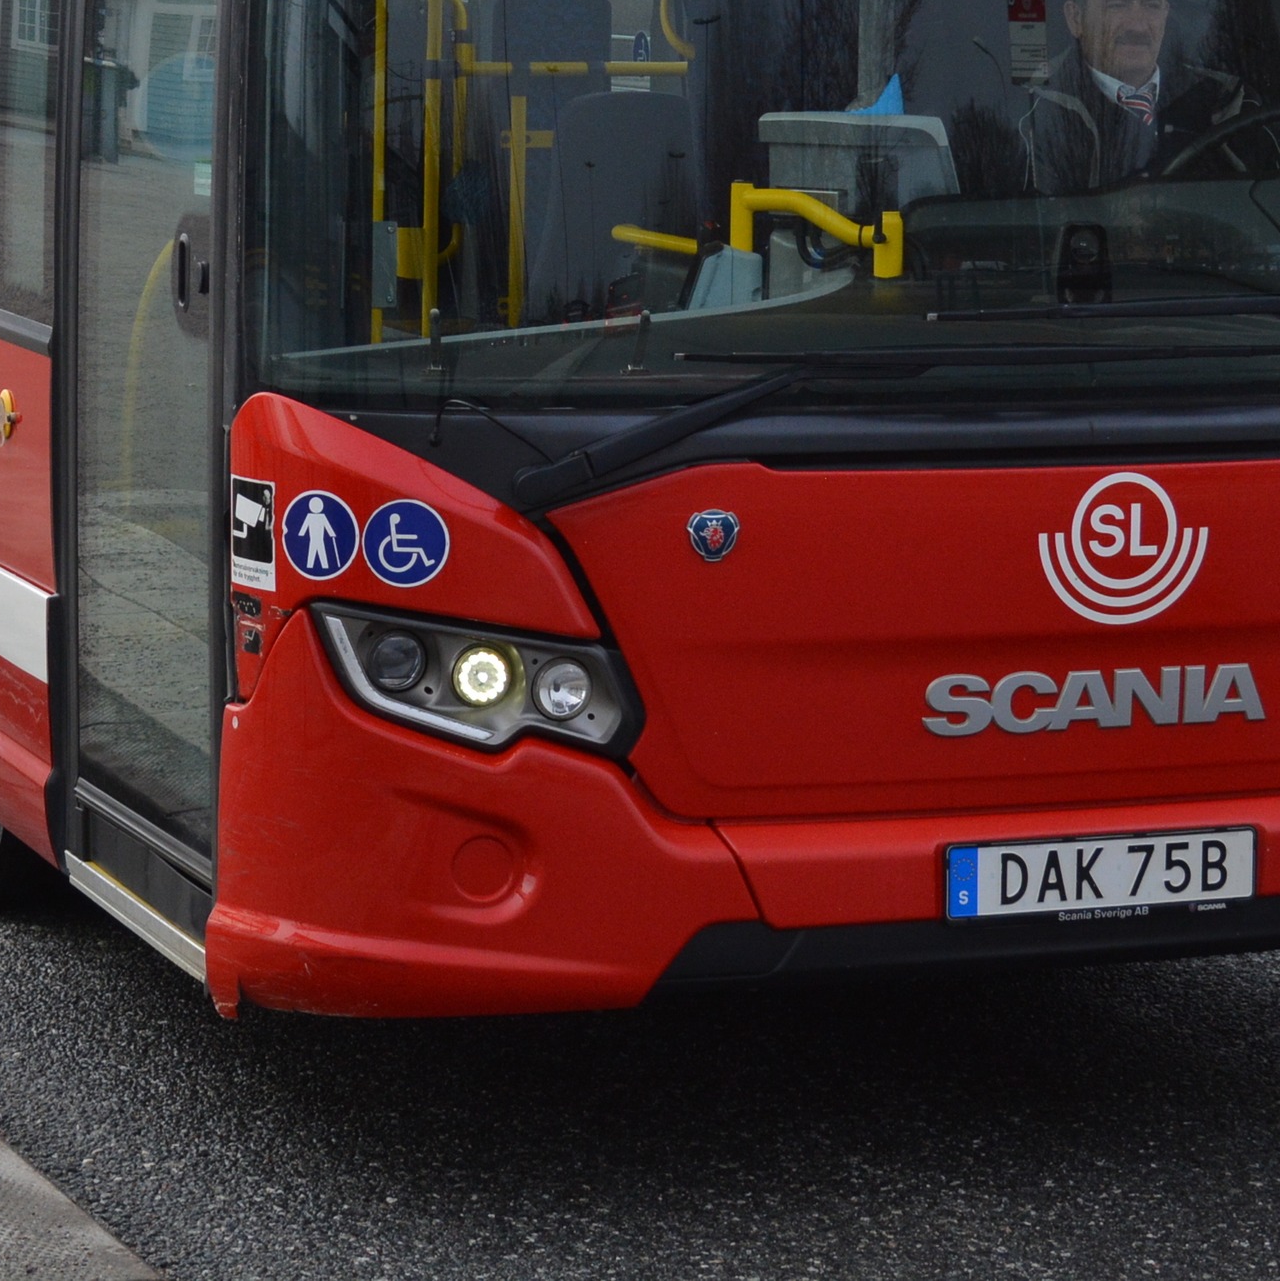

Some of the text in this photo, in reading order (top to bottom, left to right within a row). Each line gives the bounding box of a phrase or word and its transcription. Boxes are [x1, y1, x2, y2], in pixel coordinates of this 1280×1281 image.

[1089, 502, 1159, 558] SL
[922, 663, 1266, 737] SCANIA
[1000, 840, 1228, 906] DAK 75B
[958, 890, 969, 906] S
[1058, 905, 1150, 921] Scania Sverige AB
[1197, 902, 1227, 912] SCANIA
